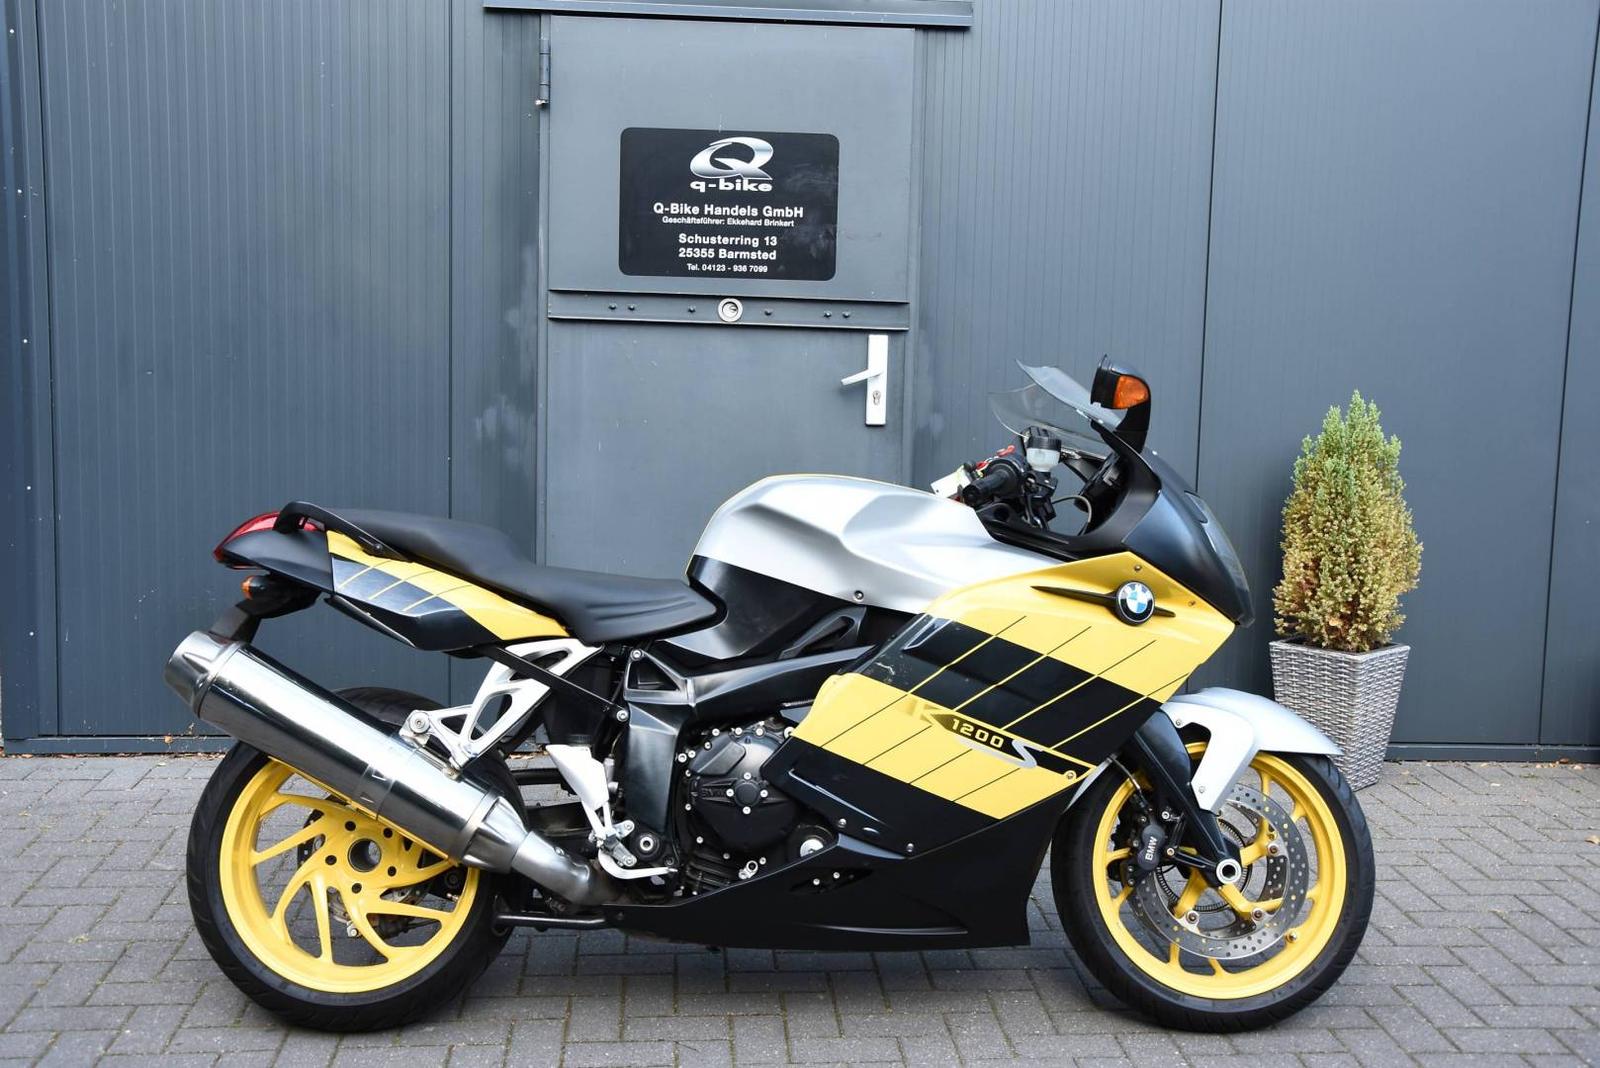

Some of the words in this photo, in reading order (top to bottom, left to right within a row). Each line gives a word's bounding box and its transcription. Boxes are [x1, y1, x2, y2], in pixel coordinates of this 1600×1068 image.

[690, 137, 774, 180] Q
[690, 179, 773, 193] q-bike
[653, 203, 700, 215] Q-Bike
[704, 204, 759, 217] Handels
[762, 205, 804, 218] GmbH
[662, 216, 725, 225] Geschäftsführer:
[727, 218, 762, 227] Ekkehard
[764, 219, 795, 227] Brinkert
[678, 233, 759, 248] Schusterring
[764, 236, 778, 247] 13
[678, 248, 715, 259] 25355
[718, 249, 777, 261] Barmsted
[686, 263, 700, 272] Tel.
[701, 264, 726, 273] 04123
[749, 265, 769, 273] 7099
[951, 718, 1004, 748] 1200
[1144, 836, 1158, 861] BMW
